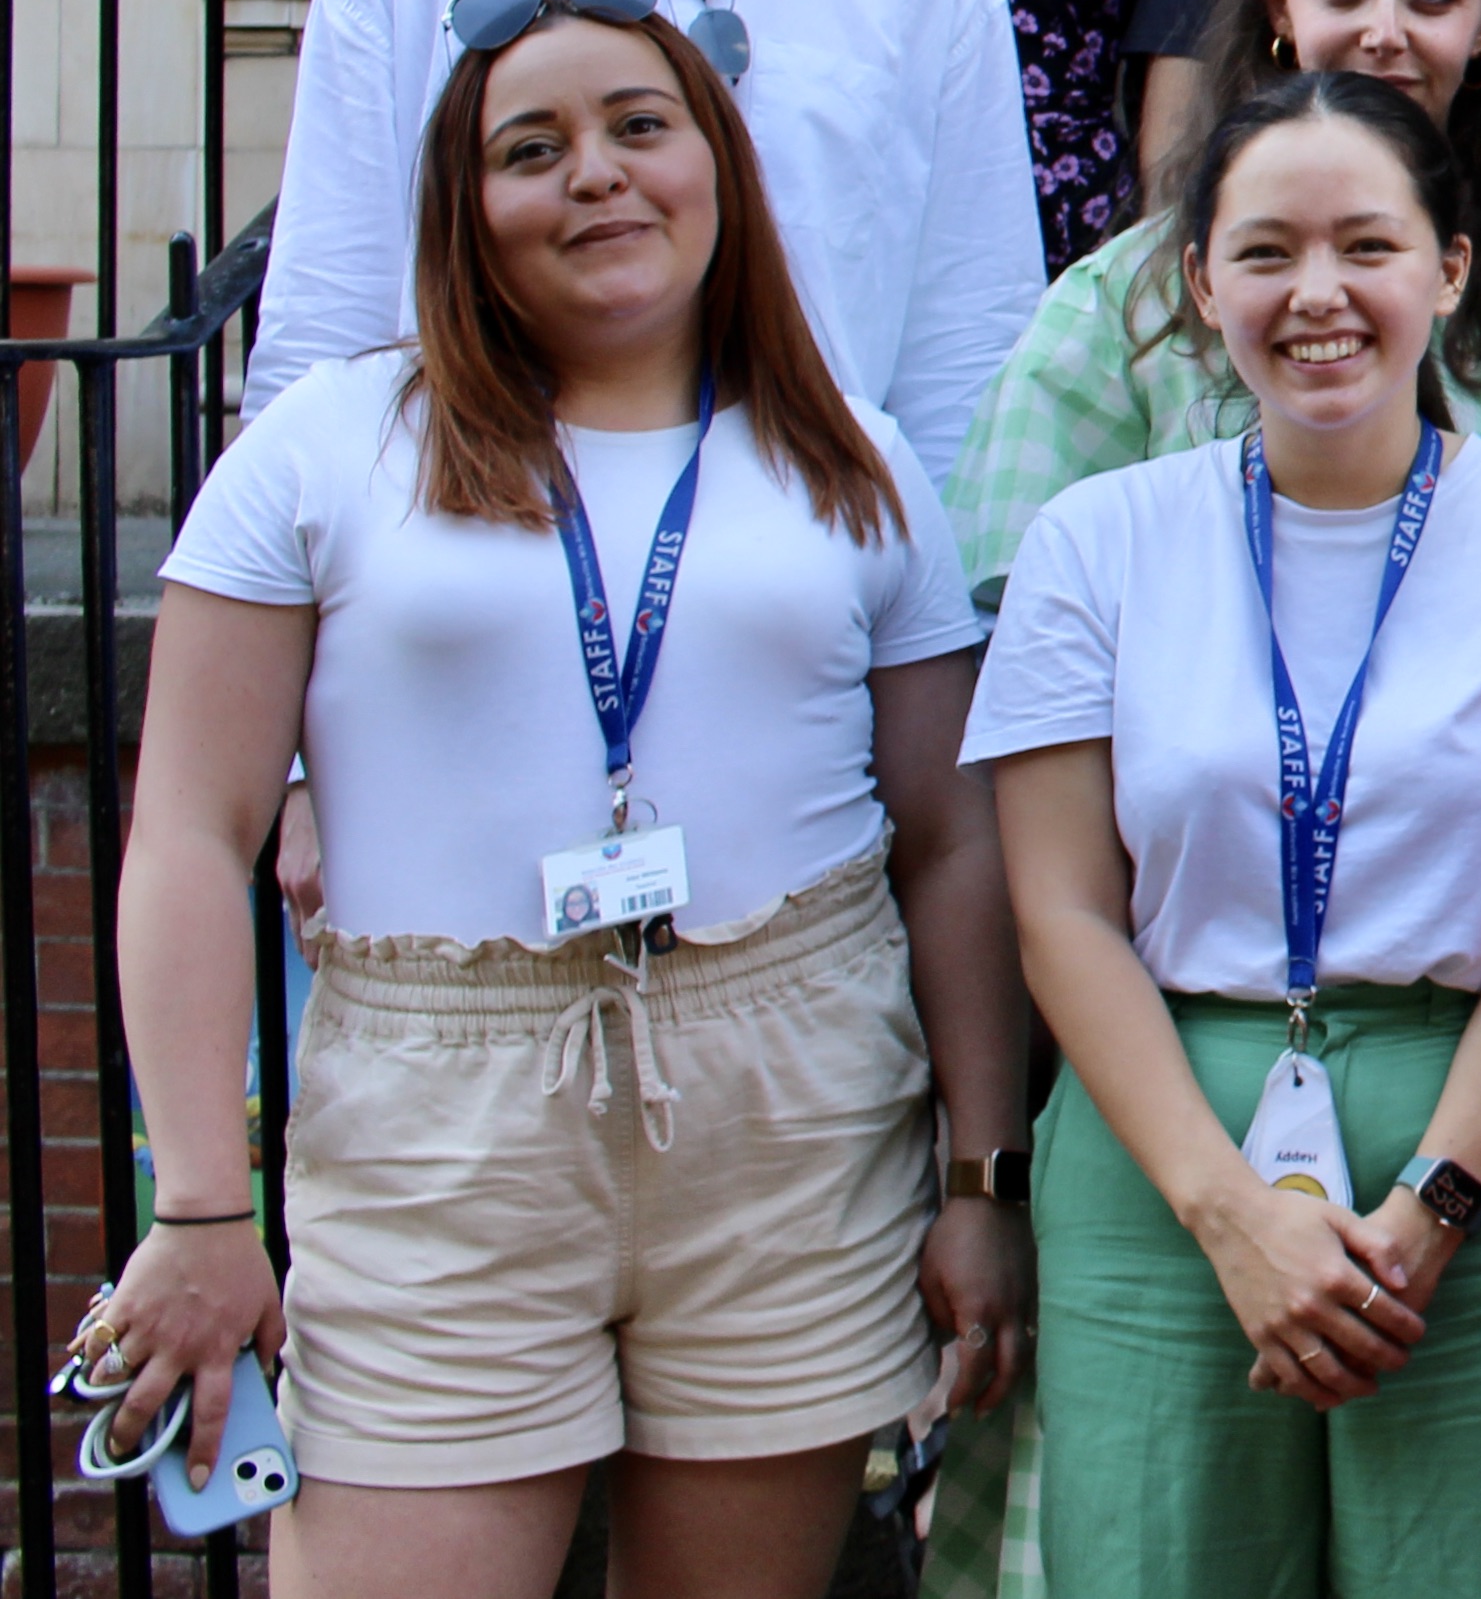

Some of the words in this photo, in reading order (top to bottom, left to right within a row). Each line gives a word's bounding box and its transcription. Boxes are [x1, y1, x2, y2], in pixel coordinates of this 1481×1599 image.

[642, 527, 683, 608] STAFF
[1387, 490, 1429, 568] STAFF
[582, 627, 621, 712] STAFF
[1277, 706, 1304, 789] STAFF
[1275, 1150, 1318, 1165] Happy
